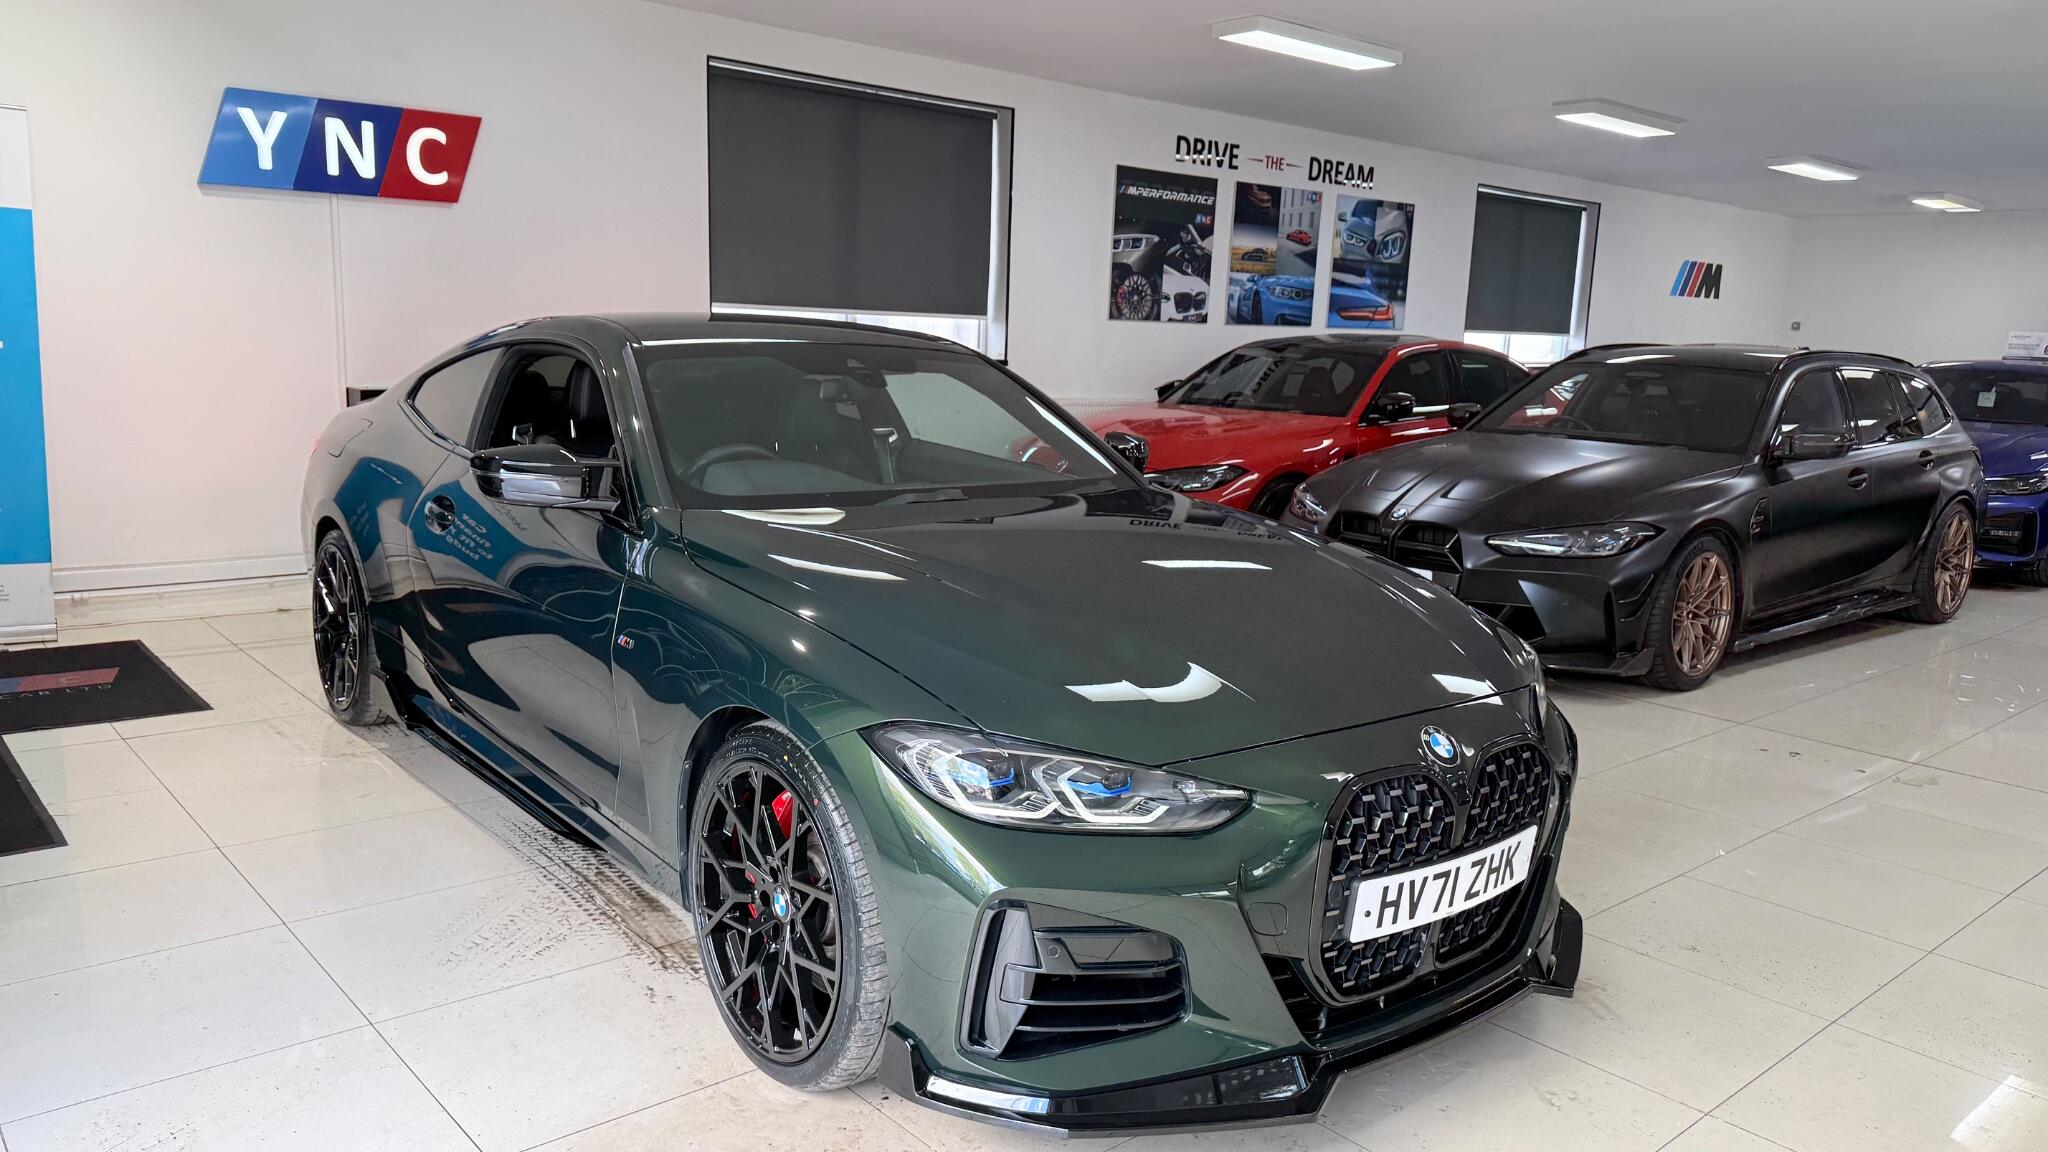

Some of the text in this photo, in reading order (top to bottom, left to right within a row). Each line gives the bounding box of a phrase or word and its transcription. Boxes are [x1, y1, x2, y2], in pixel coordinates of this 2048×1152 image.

[236, 106, 449, 186] YNC
[1175, 135, 1375, 190] DRIVE THE DREAM
[1375, 840, 1522, 929] HV71 ZHK
